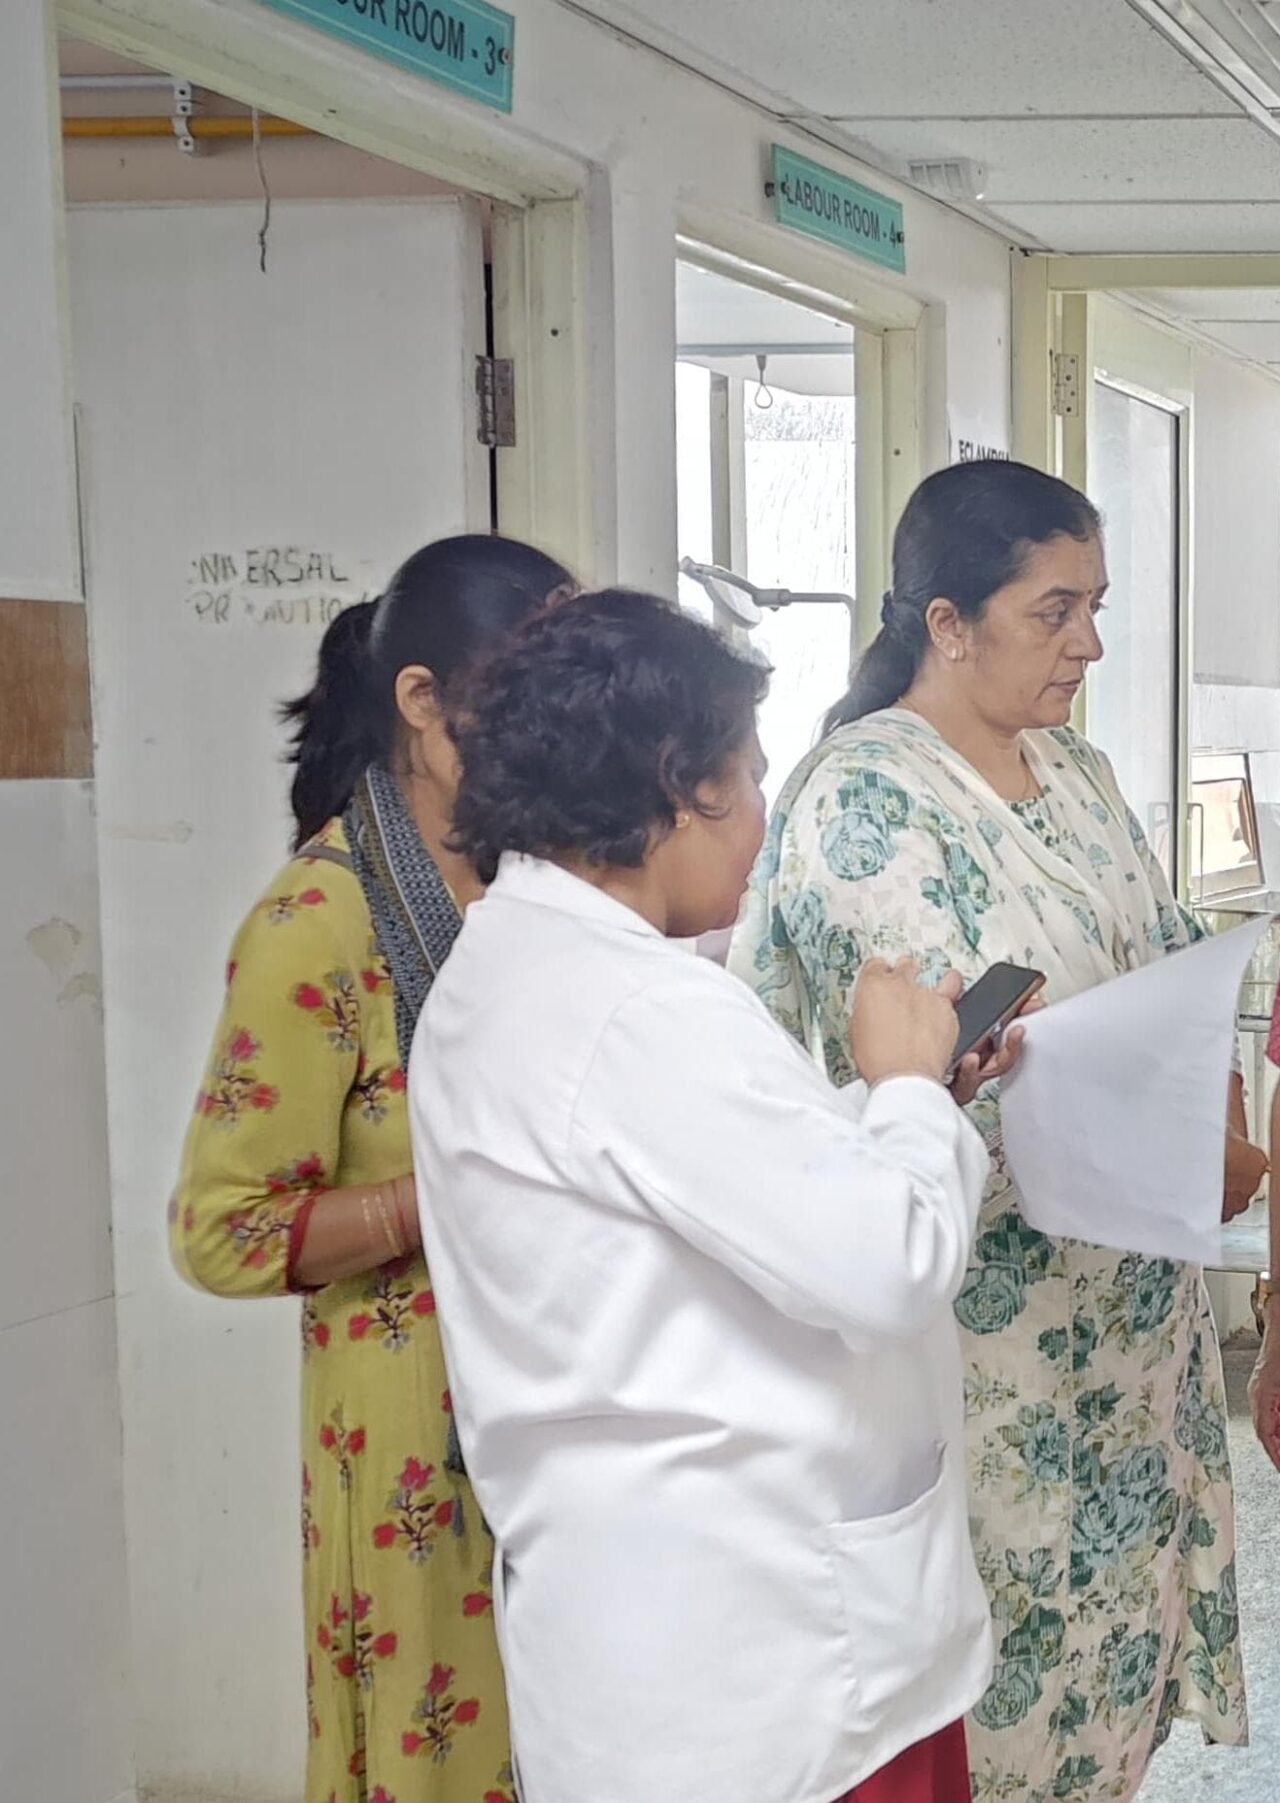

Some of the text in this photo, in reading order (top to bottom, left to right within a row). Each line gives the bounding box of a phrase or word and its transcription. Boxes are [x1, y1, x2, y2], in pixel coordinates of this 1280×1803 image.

[395, 0, 465, 62] ROOM
[483, 36, 496, 76] 3
[785, 174, 842, 225] LABOUR
[843, 199, 881, 242] ROOM
[889, 220, 899, 248] 4
[189, 548, 348, 586] NIERSAL
